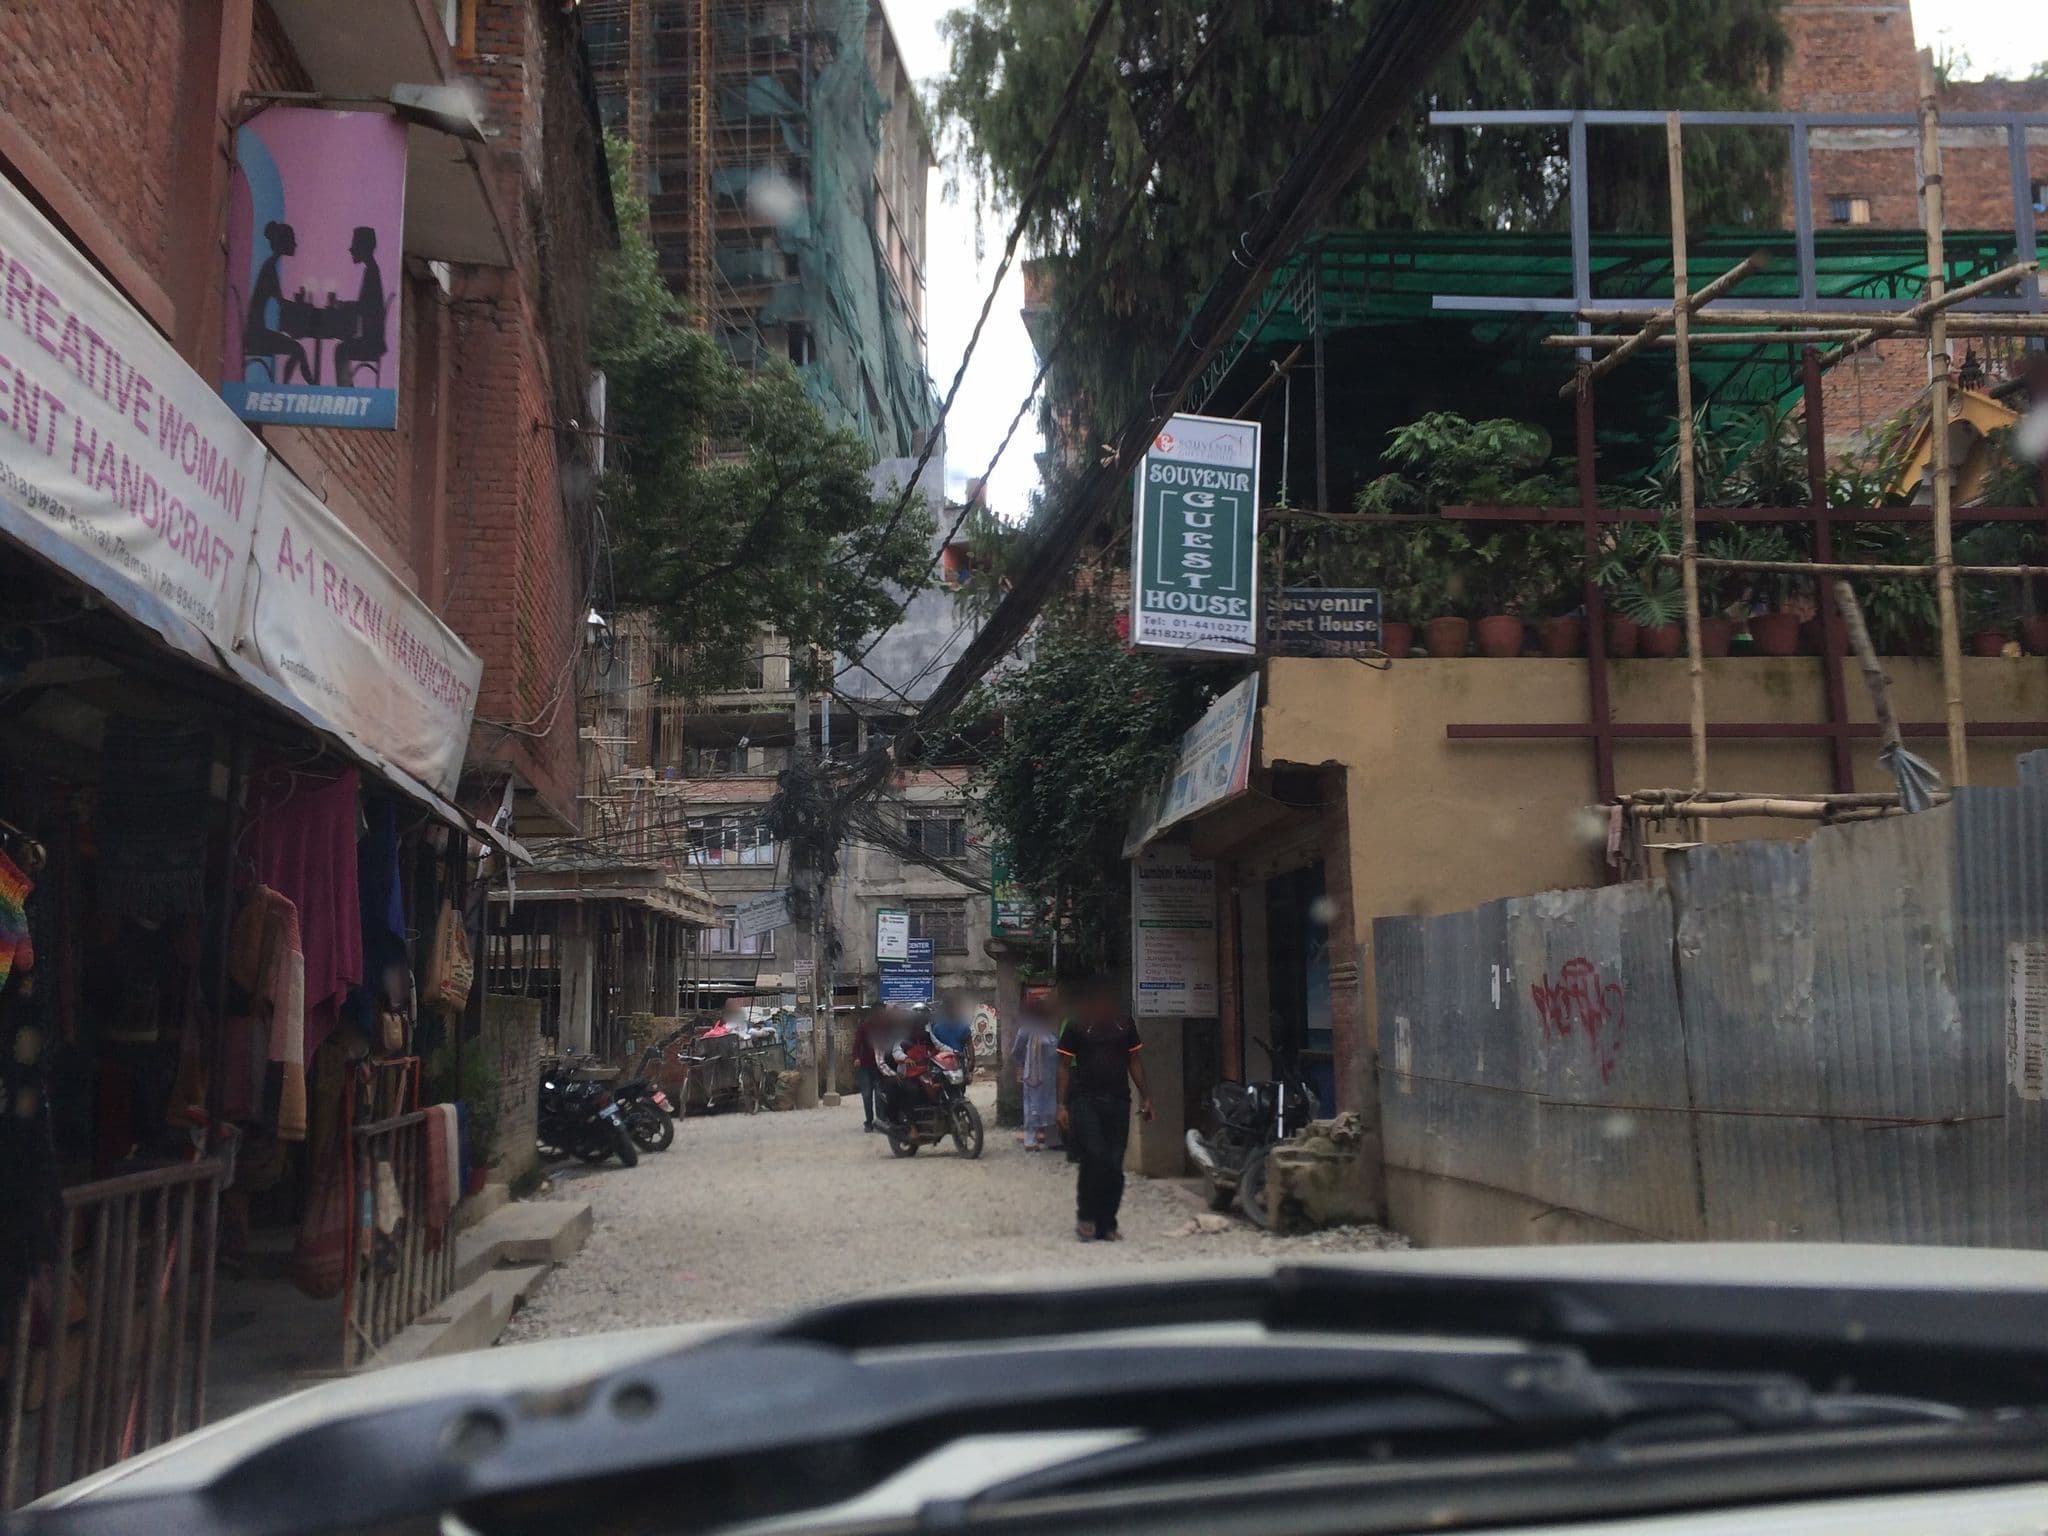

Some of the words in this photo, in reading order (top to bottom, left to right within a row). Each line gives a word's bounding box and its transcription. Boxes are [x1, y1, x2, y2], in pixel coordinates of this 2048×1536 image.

[0, 248, 153, 436] REATIVE
[159, 395, 246, 523] WOMAN
[245, 391, 372, 417] RESTAURANT
[1149, 463, 1250, 492] SOUVENIR
[71, 415, 235, 594] HANDICRAFT
[1180, 490, 1216, 589] GUEST
[277, 526, 315, 597] A-1
[1145, 589, 1248, 617] HOUSE
[1266, 598, 1374, 613] Souvenir
[1143, 615, 1166, 626] Tel:
[1172, 618, 1248, 634] 01-4410277
[1319, 615, 1378, 632] House
